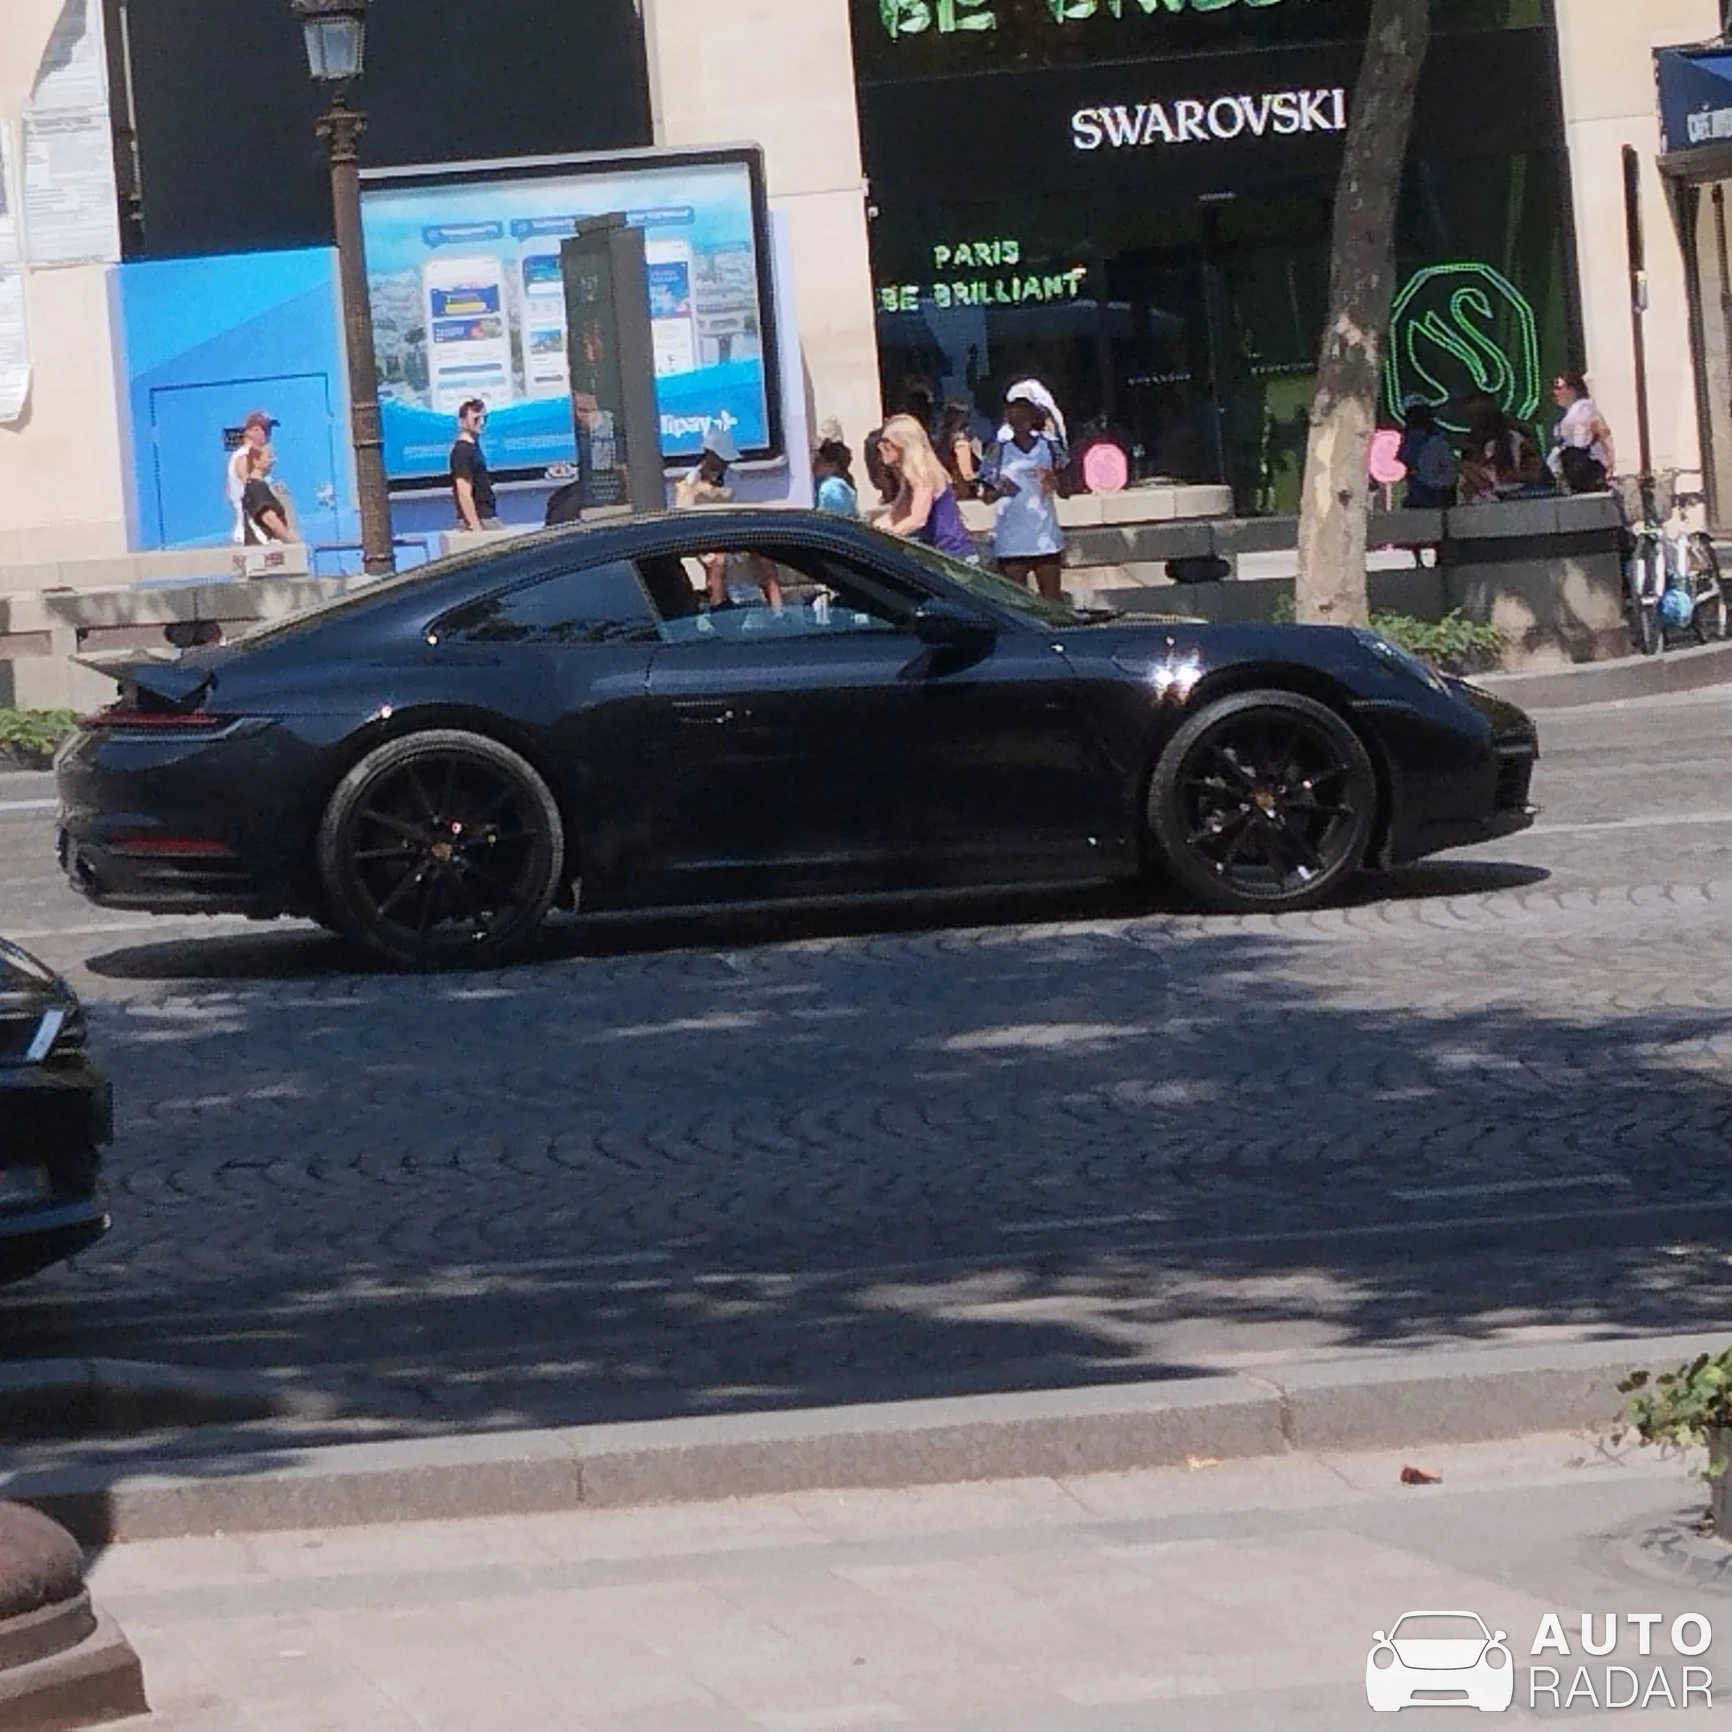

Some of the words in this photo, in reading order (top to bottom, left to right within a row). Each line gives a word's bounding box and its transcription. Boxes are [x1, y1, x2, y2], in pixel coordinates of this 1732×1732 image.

[1072, 88, 1346, 149] SWAROVSKI
[934, 238, 1019, 269] PARIS
[934, 265, 1087, 308] BRILLIANT
